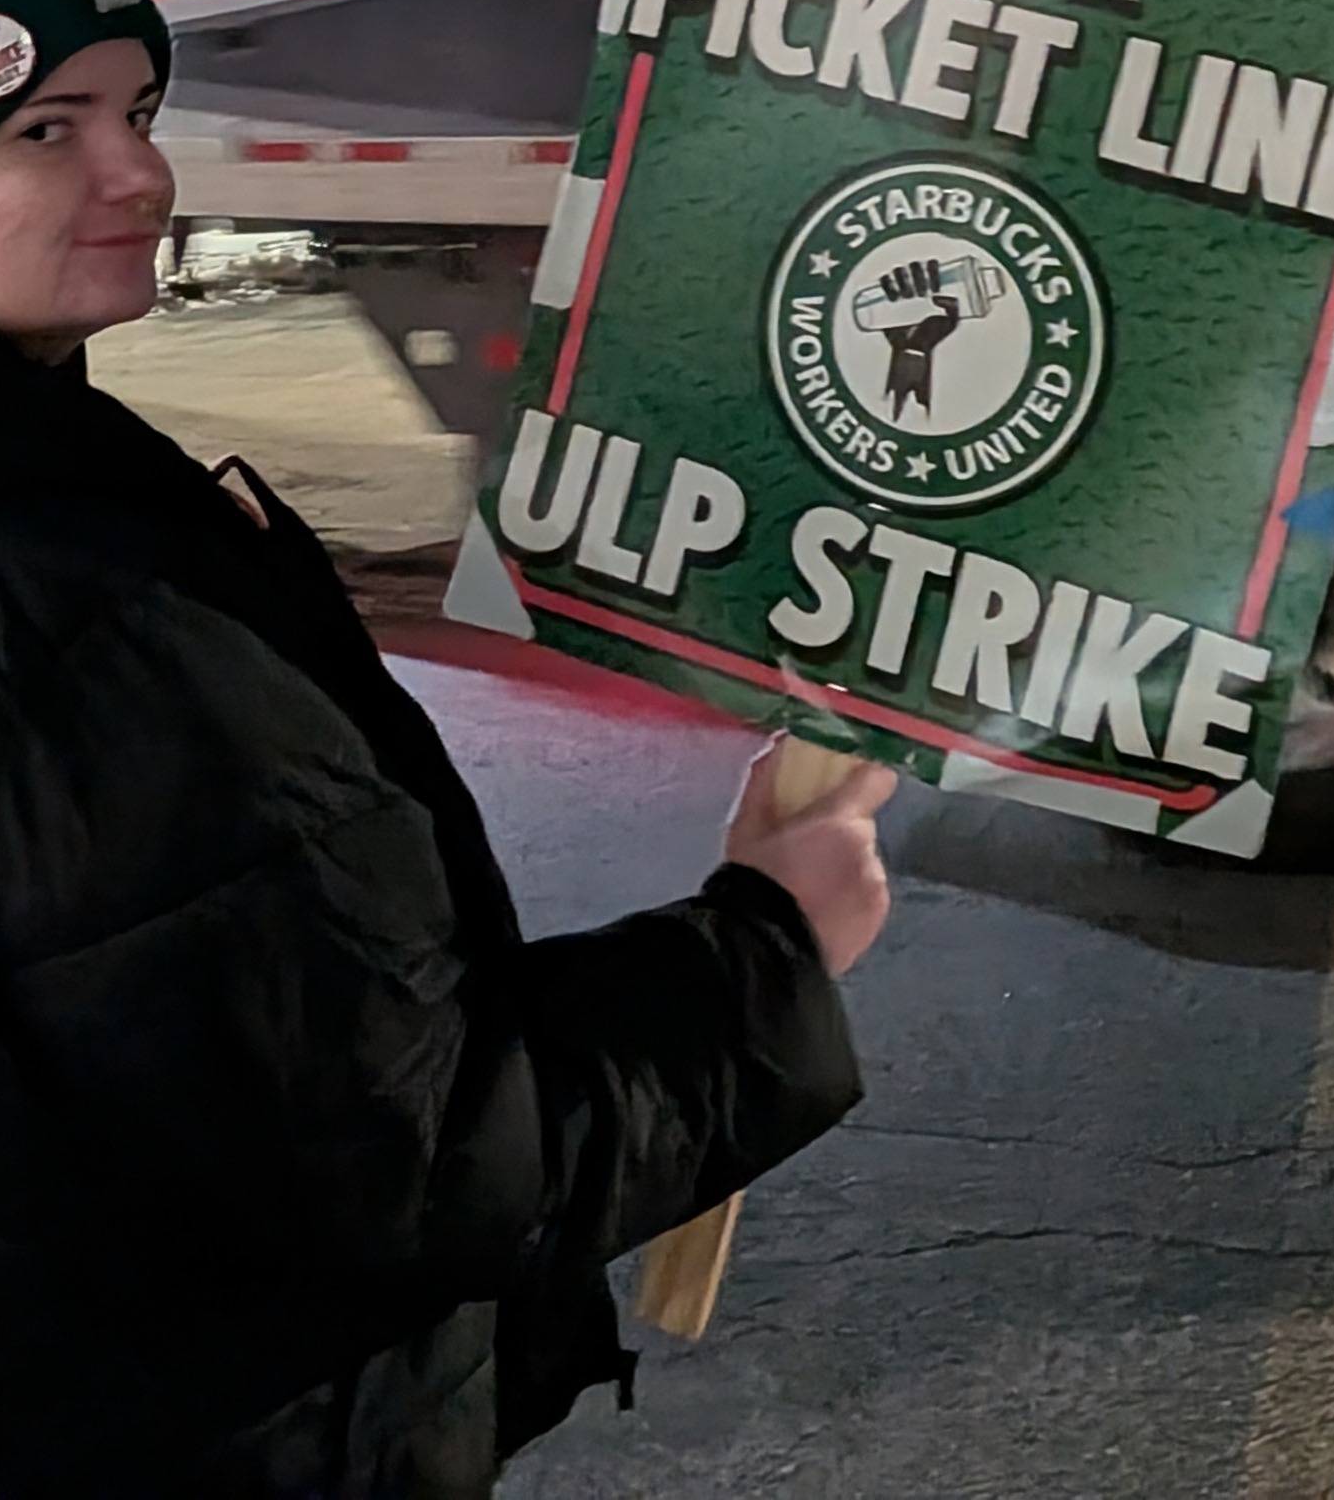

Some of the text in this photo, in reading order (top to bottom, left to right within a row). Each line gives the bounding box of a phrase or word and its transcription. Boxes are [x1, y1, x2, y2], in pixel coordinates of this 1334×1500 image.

[835, 184, 1072, 304] STARBUCKS
[789, 296, 898, 474] WORKERS
[944, 363, 1072, 481] UNITED
[499, 409, 1273, 781] ULP STRIKE
